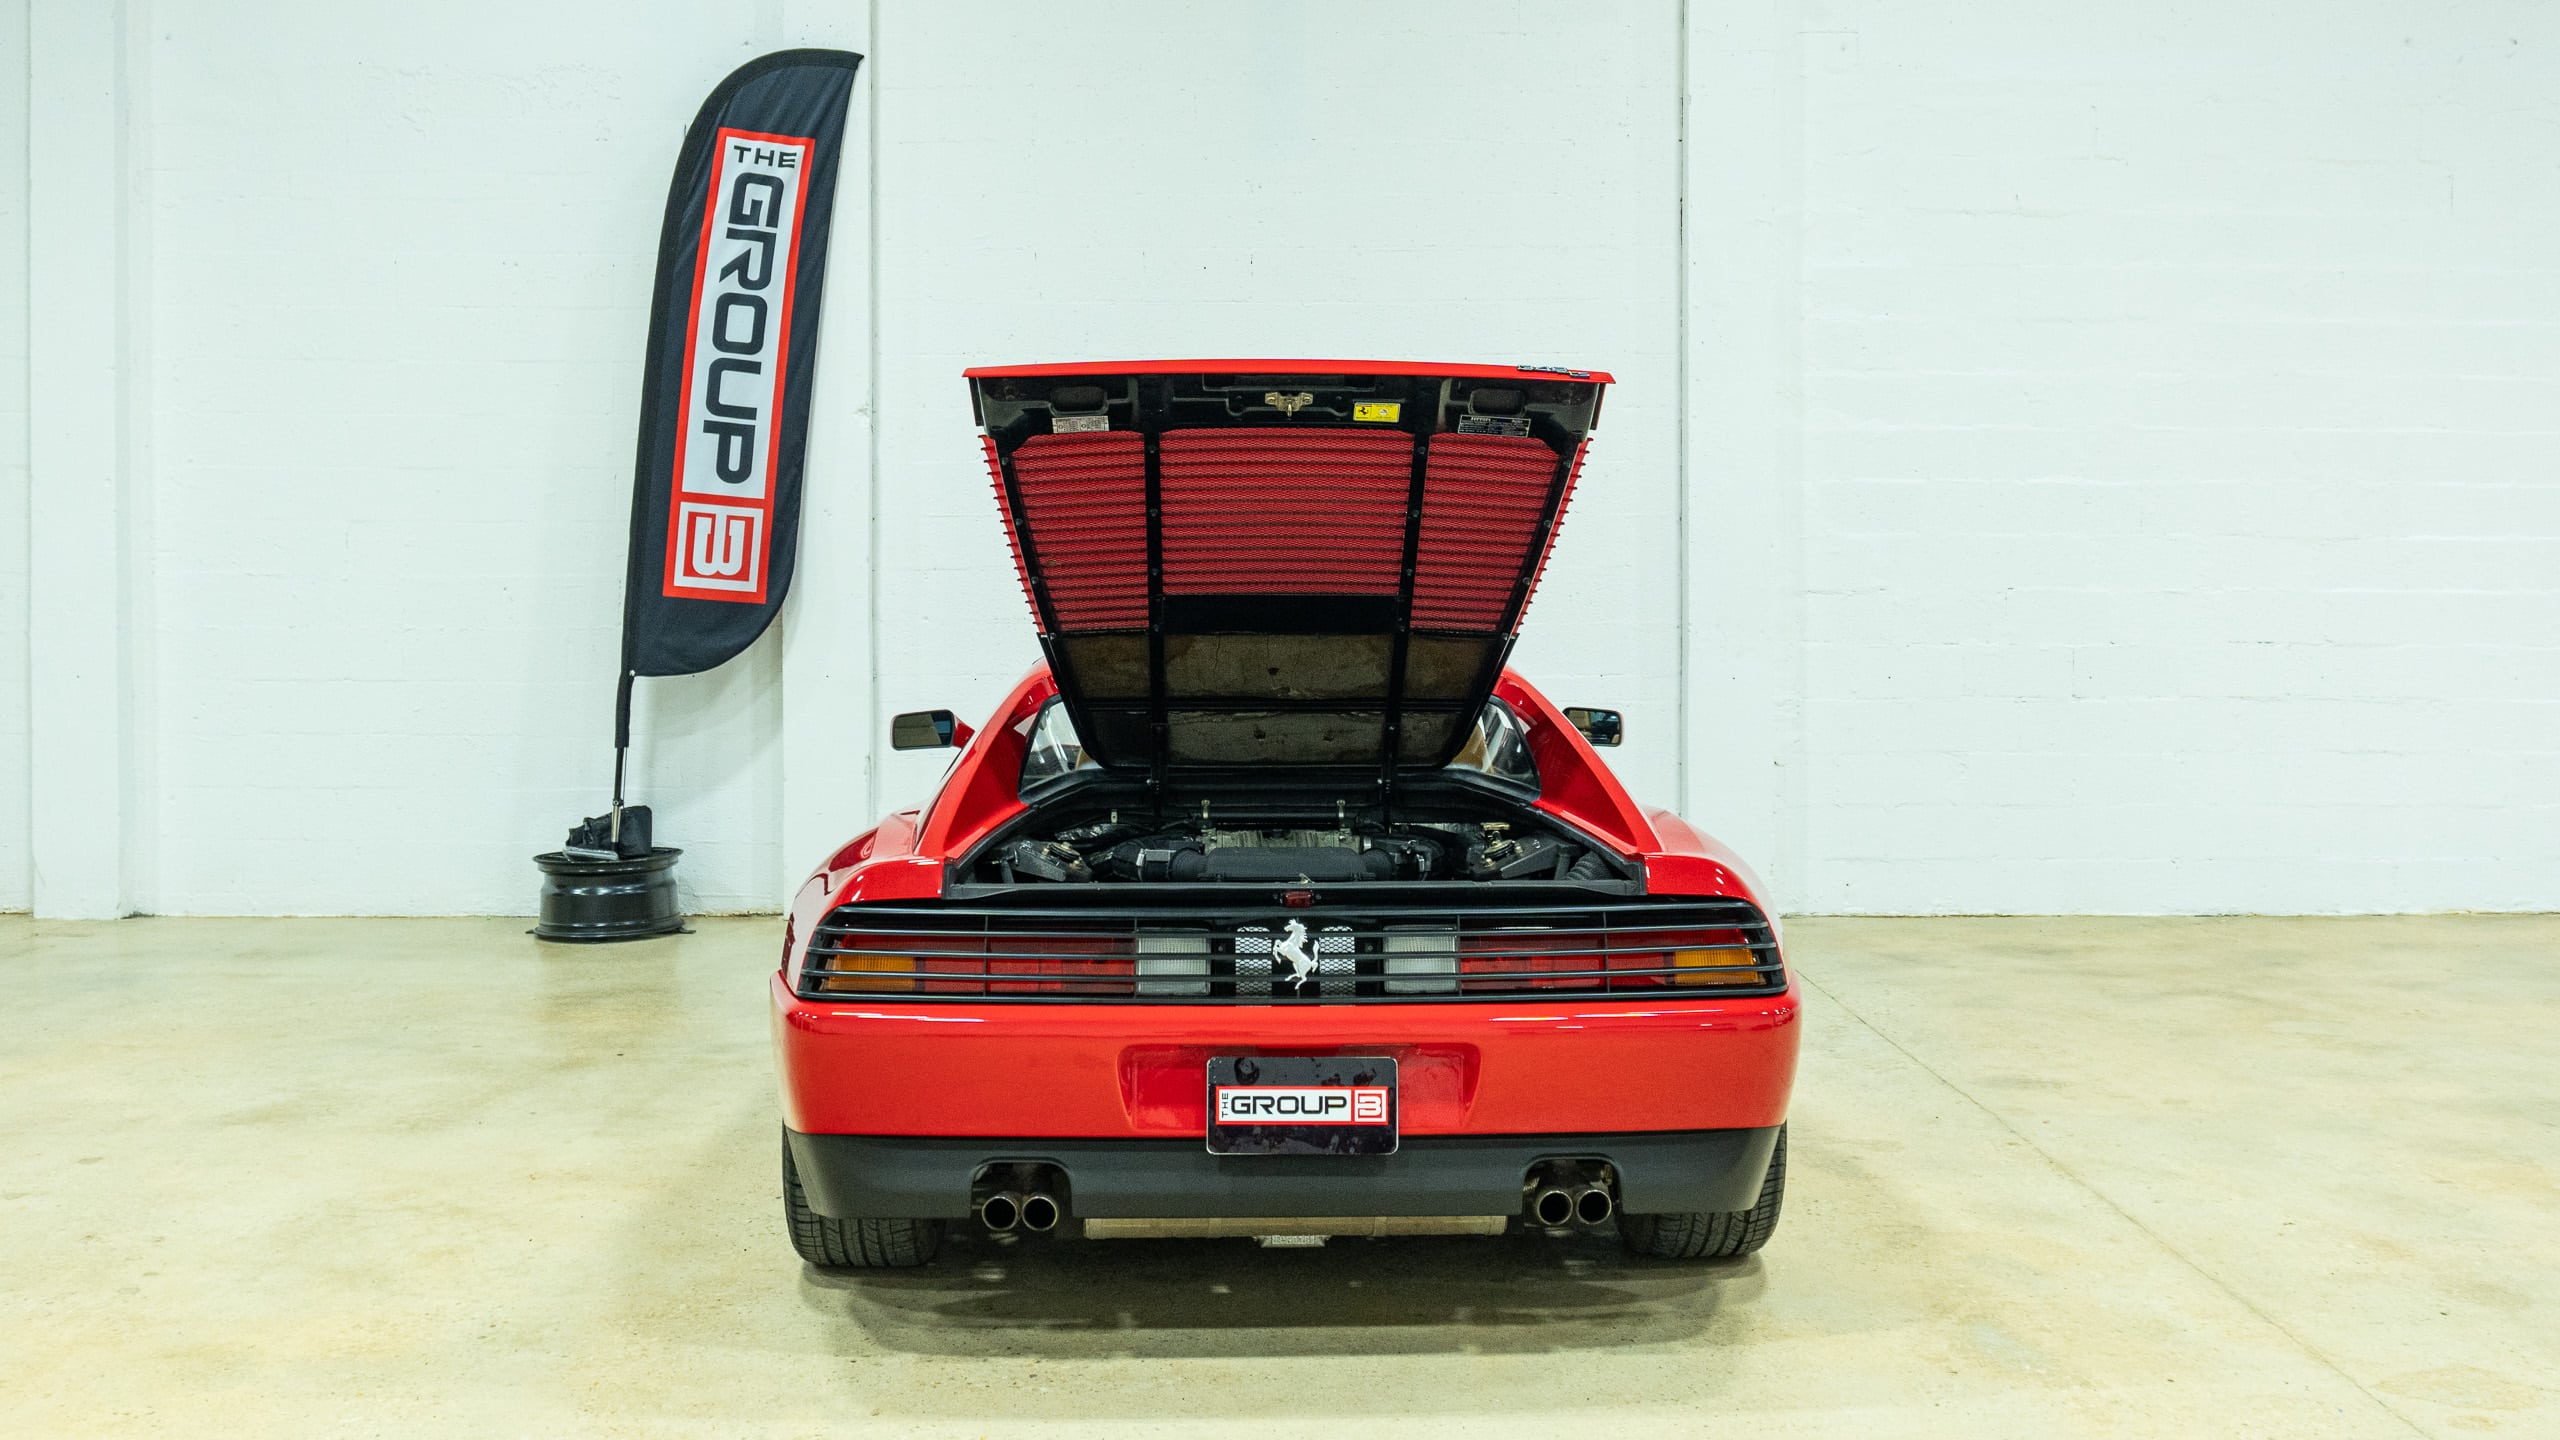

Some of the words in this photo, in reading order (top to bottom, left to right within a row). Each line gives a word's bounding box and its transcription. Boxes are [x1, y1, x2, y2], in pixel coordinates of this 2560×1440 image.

[733, 143, 798, 169] THE
[702, 171, 785, 485] GROUP
[1221, 1092, 1229, 1119] THE
[1230, 1095, 1348, 1115] GROUP
